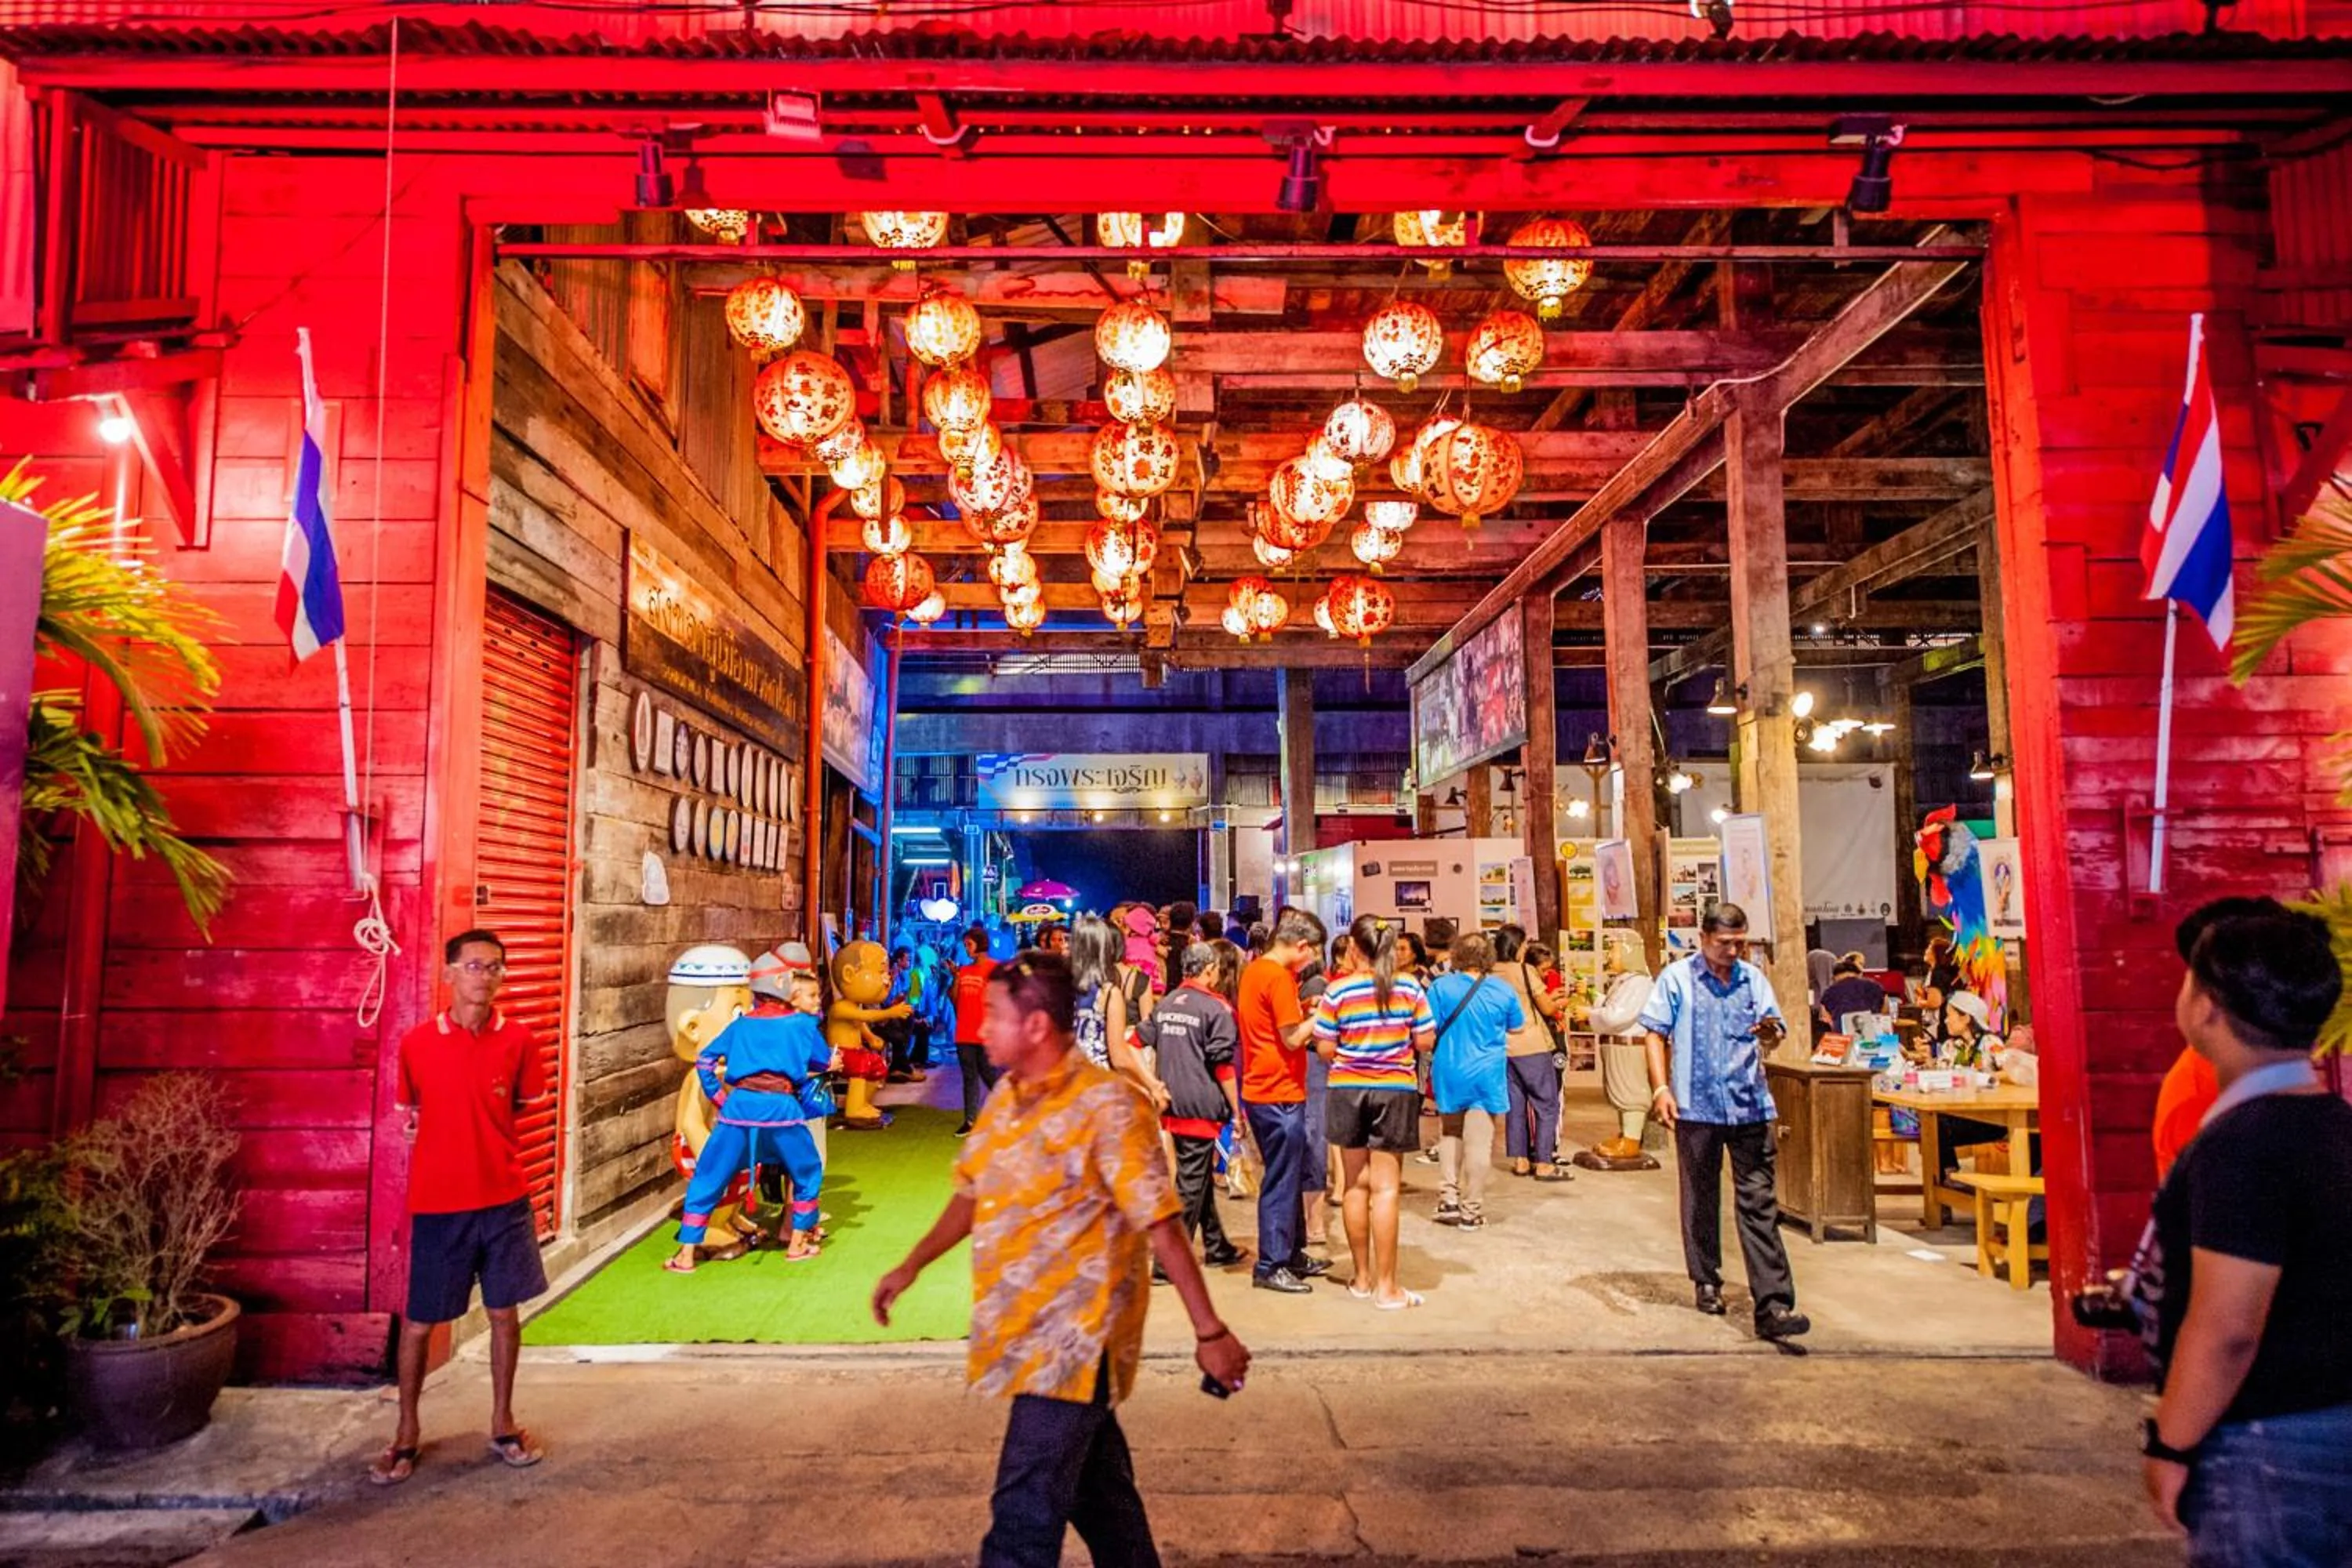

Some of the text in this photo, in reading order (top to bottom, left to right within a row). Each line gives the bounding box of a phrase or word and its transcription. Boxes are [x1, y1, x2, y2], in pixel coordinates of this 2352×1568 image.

[1016, 764, 1167, 789] ทรงพระเจริญ
